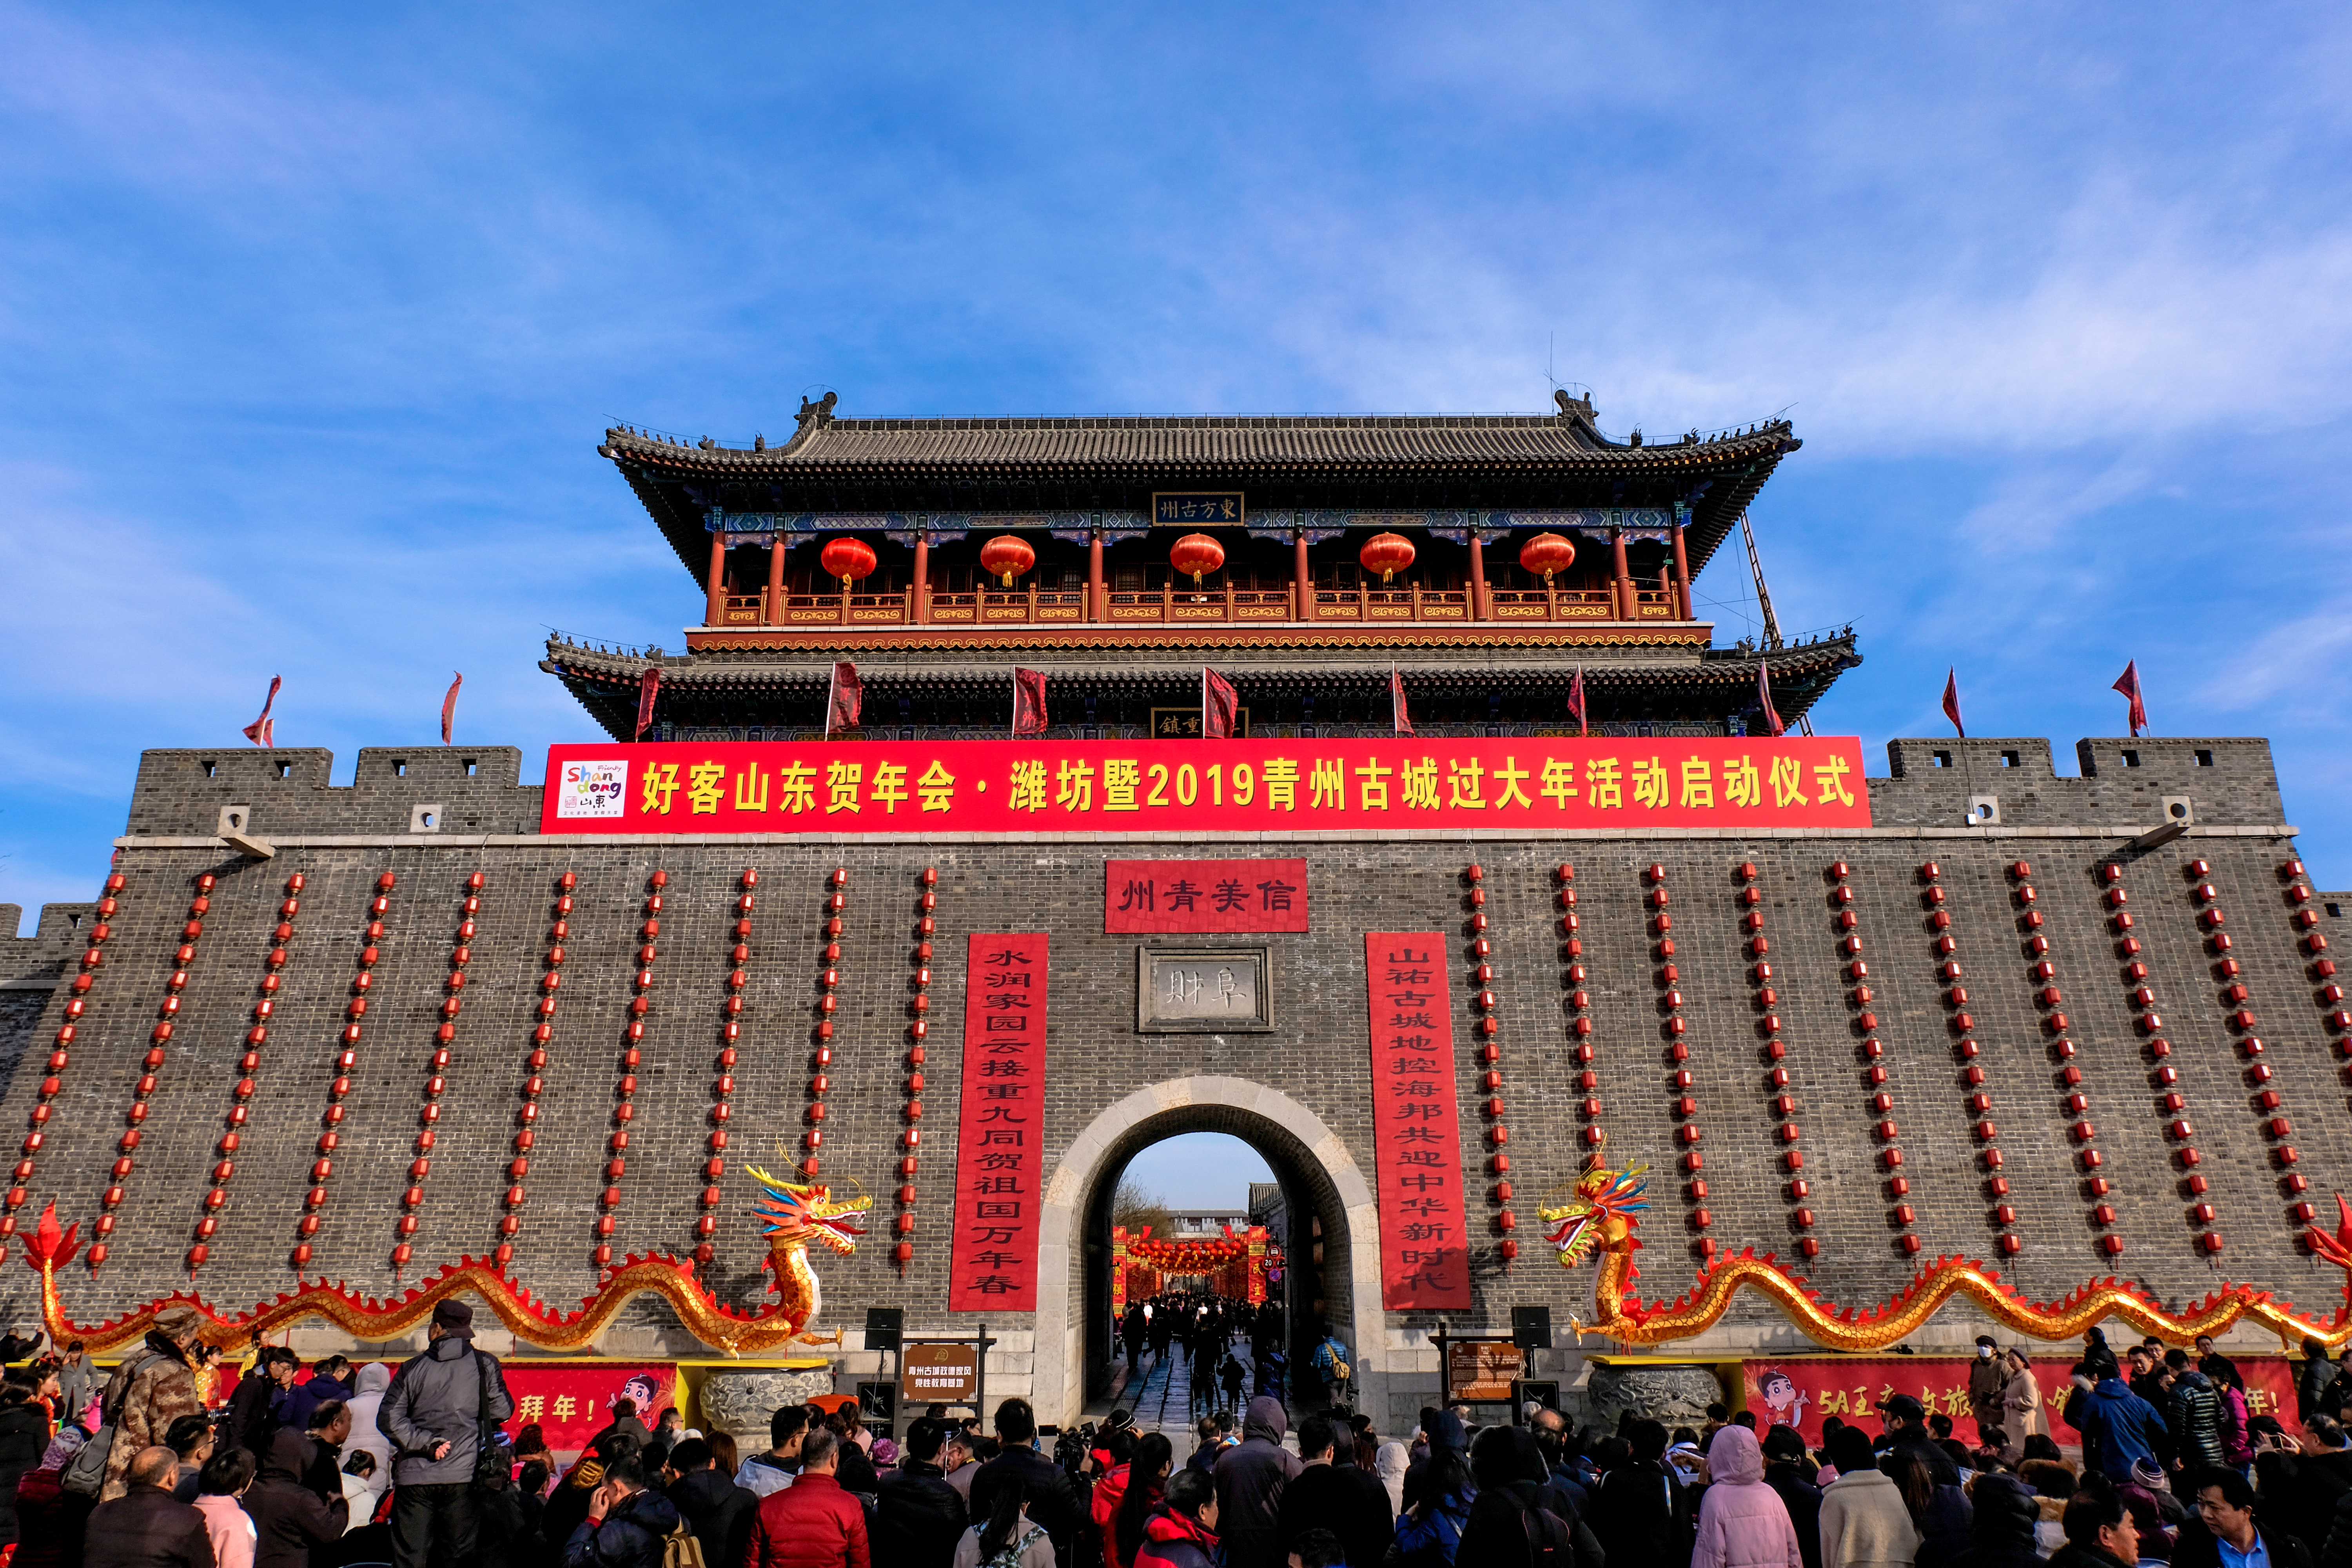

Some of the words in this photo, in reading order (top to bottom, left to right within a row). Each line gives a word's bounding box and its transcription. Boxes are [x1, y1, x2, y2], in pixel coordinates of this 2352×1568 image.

[1161, 498, 1236, 519] 東方古州
[568, 765, 613, 782] Shan
[577, 780, 621, 799] dong
[1118, 878, 1296, 912] 信美青州
[1166, 967, 1246, 1009] 阜財
[967, 950, 1033, 1294] 水润家园云接重九同贺祖国万年春
[1385, 949, 1455, 1291] 山祐古城地控海邦共迎中华新时代
[1253, 1263, 1263, 1295] 民主
[908, 1366, 971, 1376] 青州古城政德家风
[915, 1378, 964, 1387] 党性教育基地
